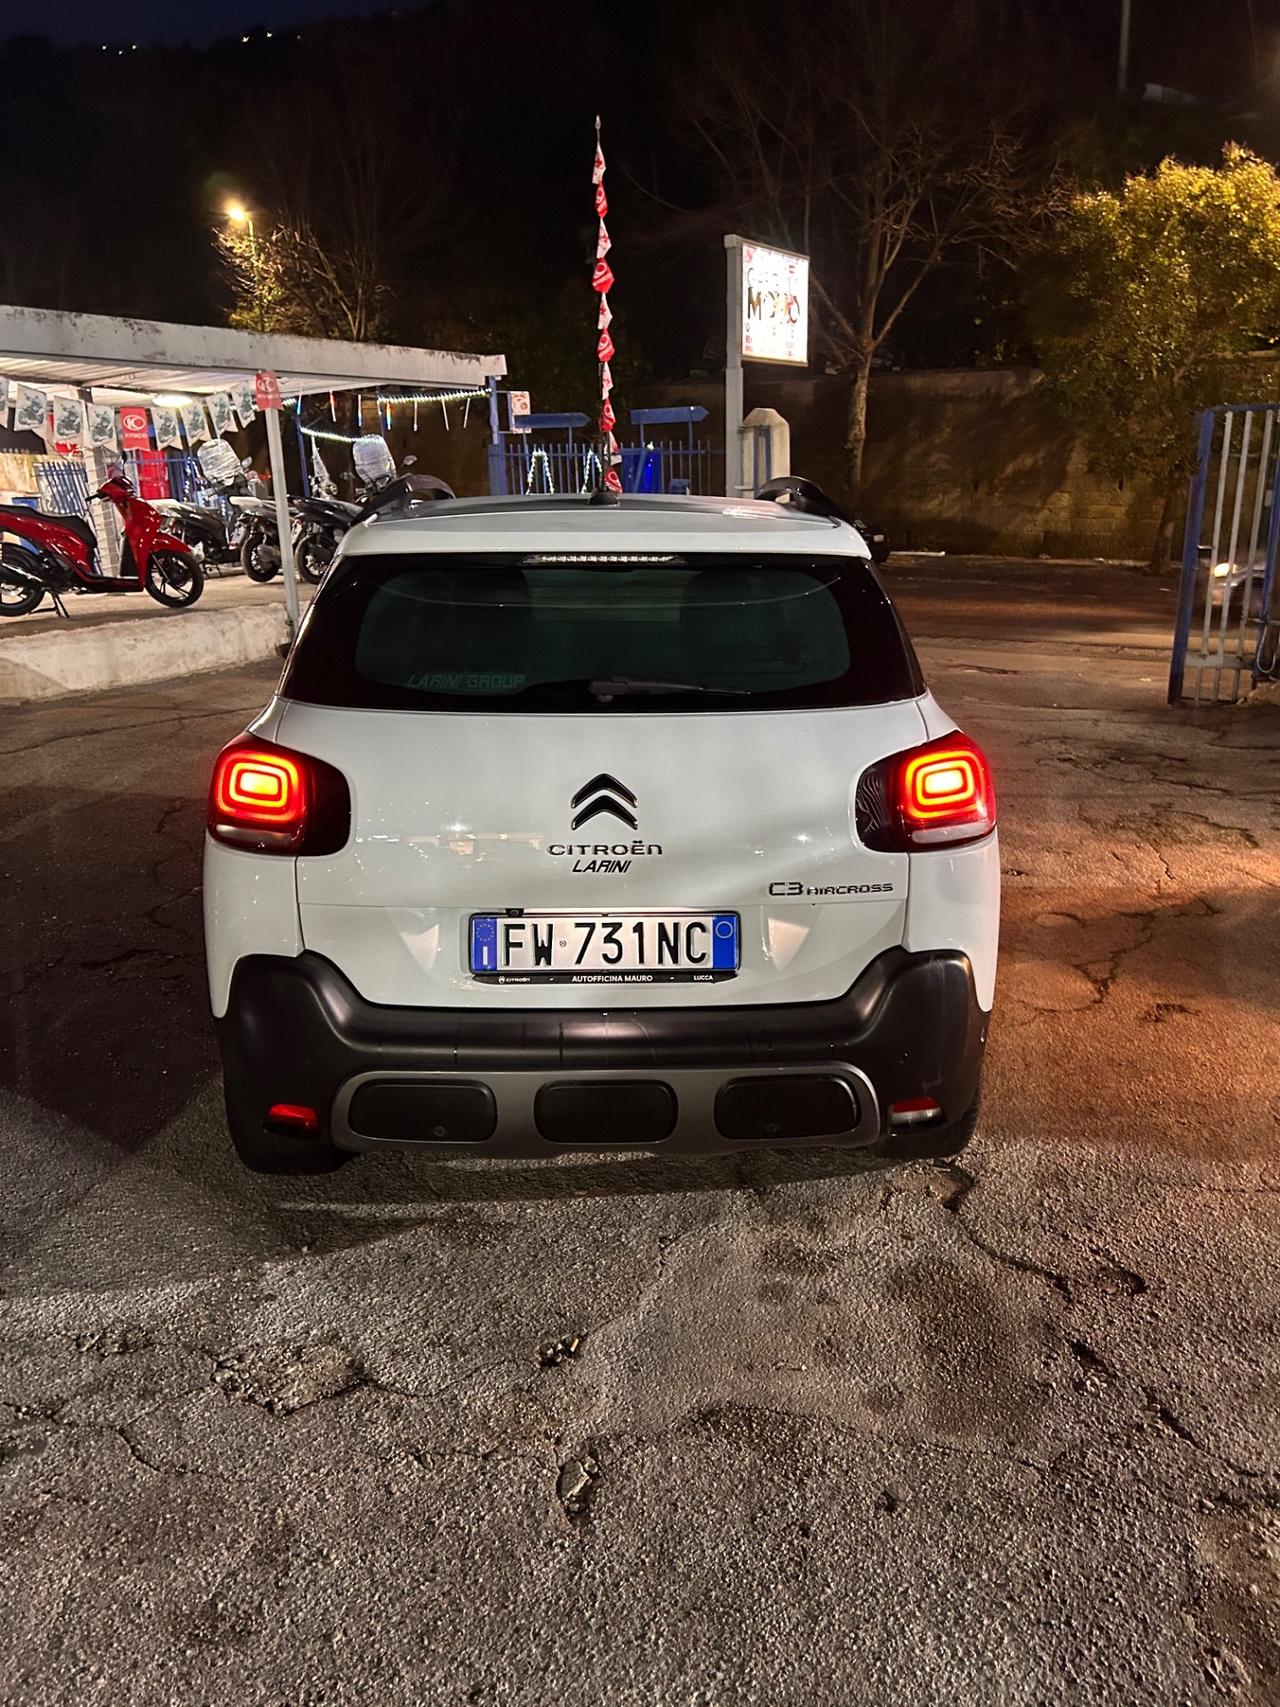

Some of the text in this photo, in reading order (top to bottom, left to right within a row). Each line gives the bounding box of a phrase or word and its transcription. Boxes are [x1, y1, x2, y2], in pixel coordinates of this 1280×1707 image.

[467, 674, 526, 689] GROUP
[572, 860, 632, 873] LARINI
[768, 882, 894, 896] C3 AIRCROSS
[571, 975, 623, 983] AUTOFFICINA
[624, 975, 653, 983] MAURO
